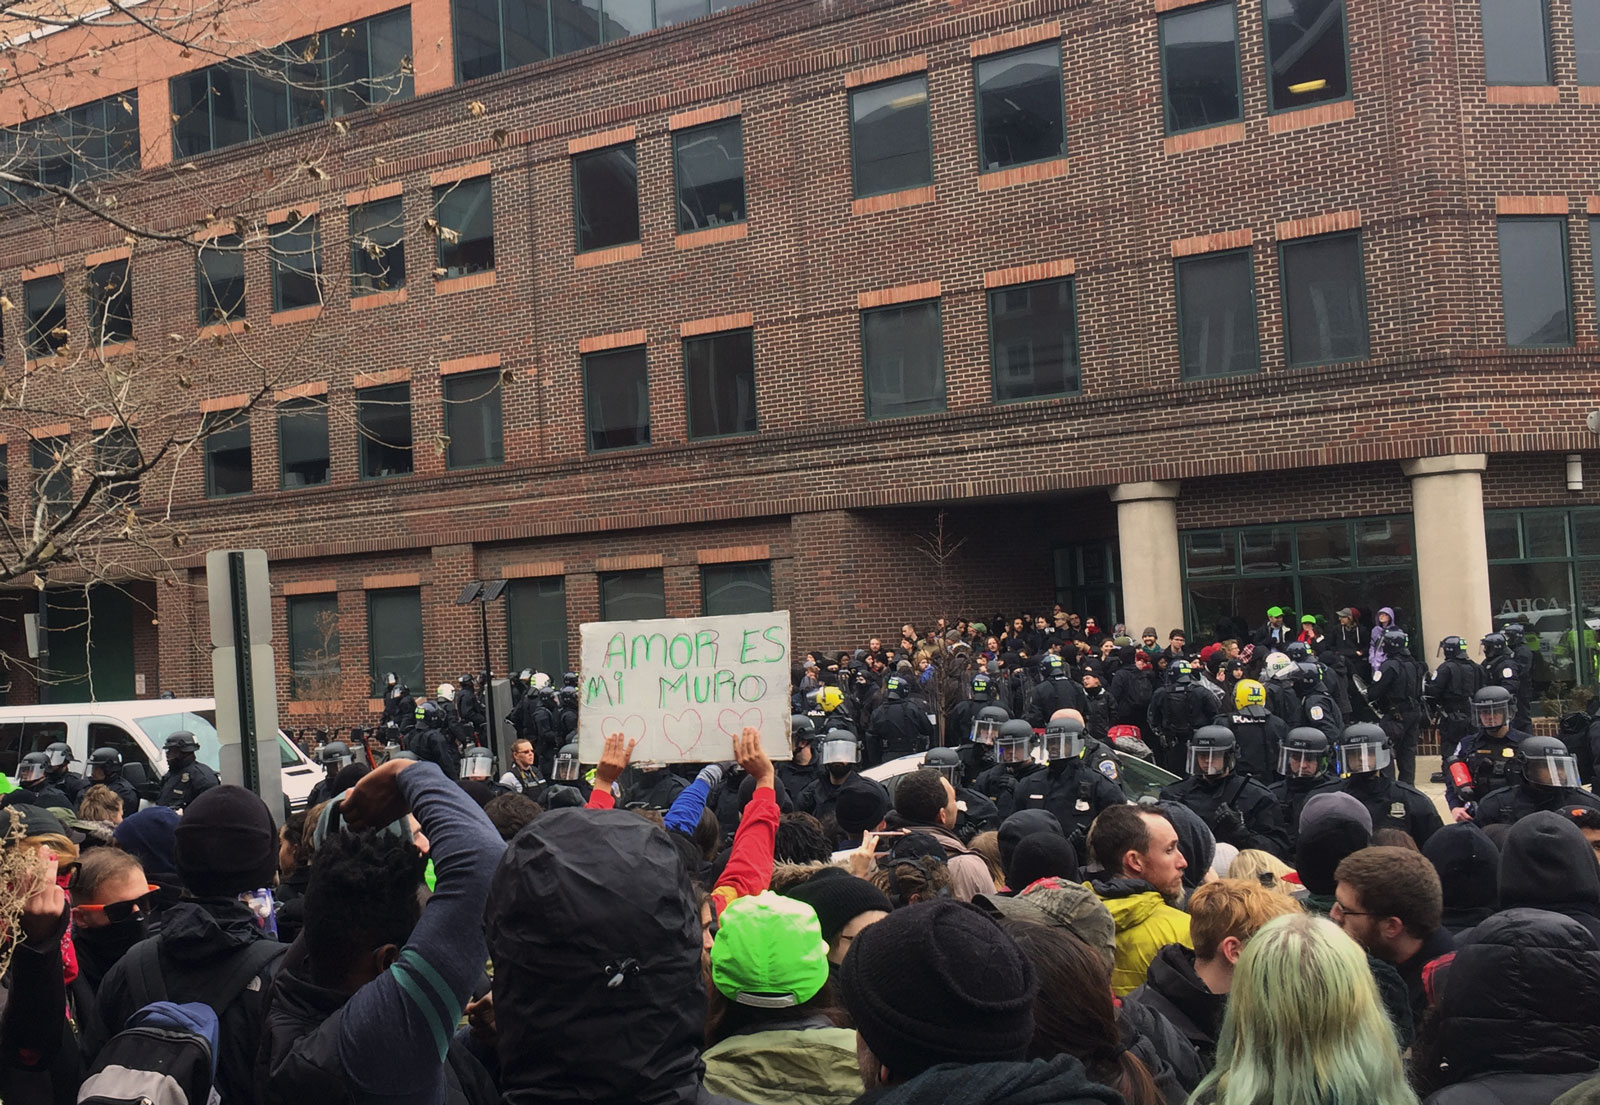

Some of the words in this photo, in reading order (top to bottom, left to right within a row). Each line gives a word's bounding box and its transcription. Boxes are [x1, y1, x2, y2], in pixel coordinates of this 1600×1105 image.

[1500, 597, 1559, 614] AHCA
[602, 629, 719, 669] AMOR
[740, 625, 786, 664] ES
[658, 669, 768, 709] MURO
